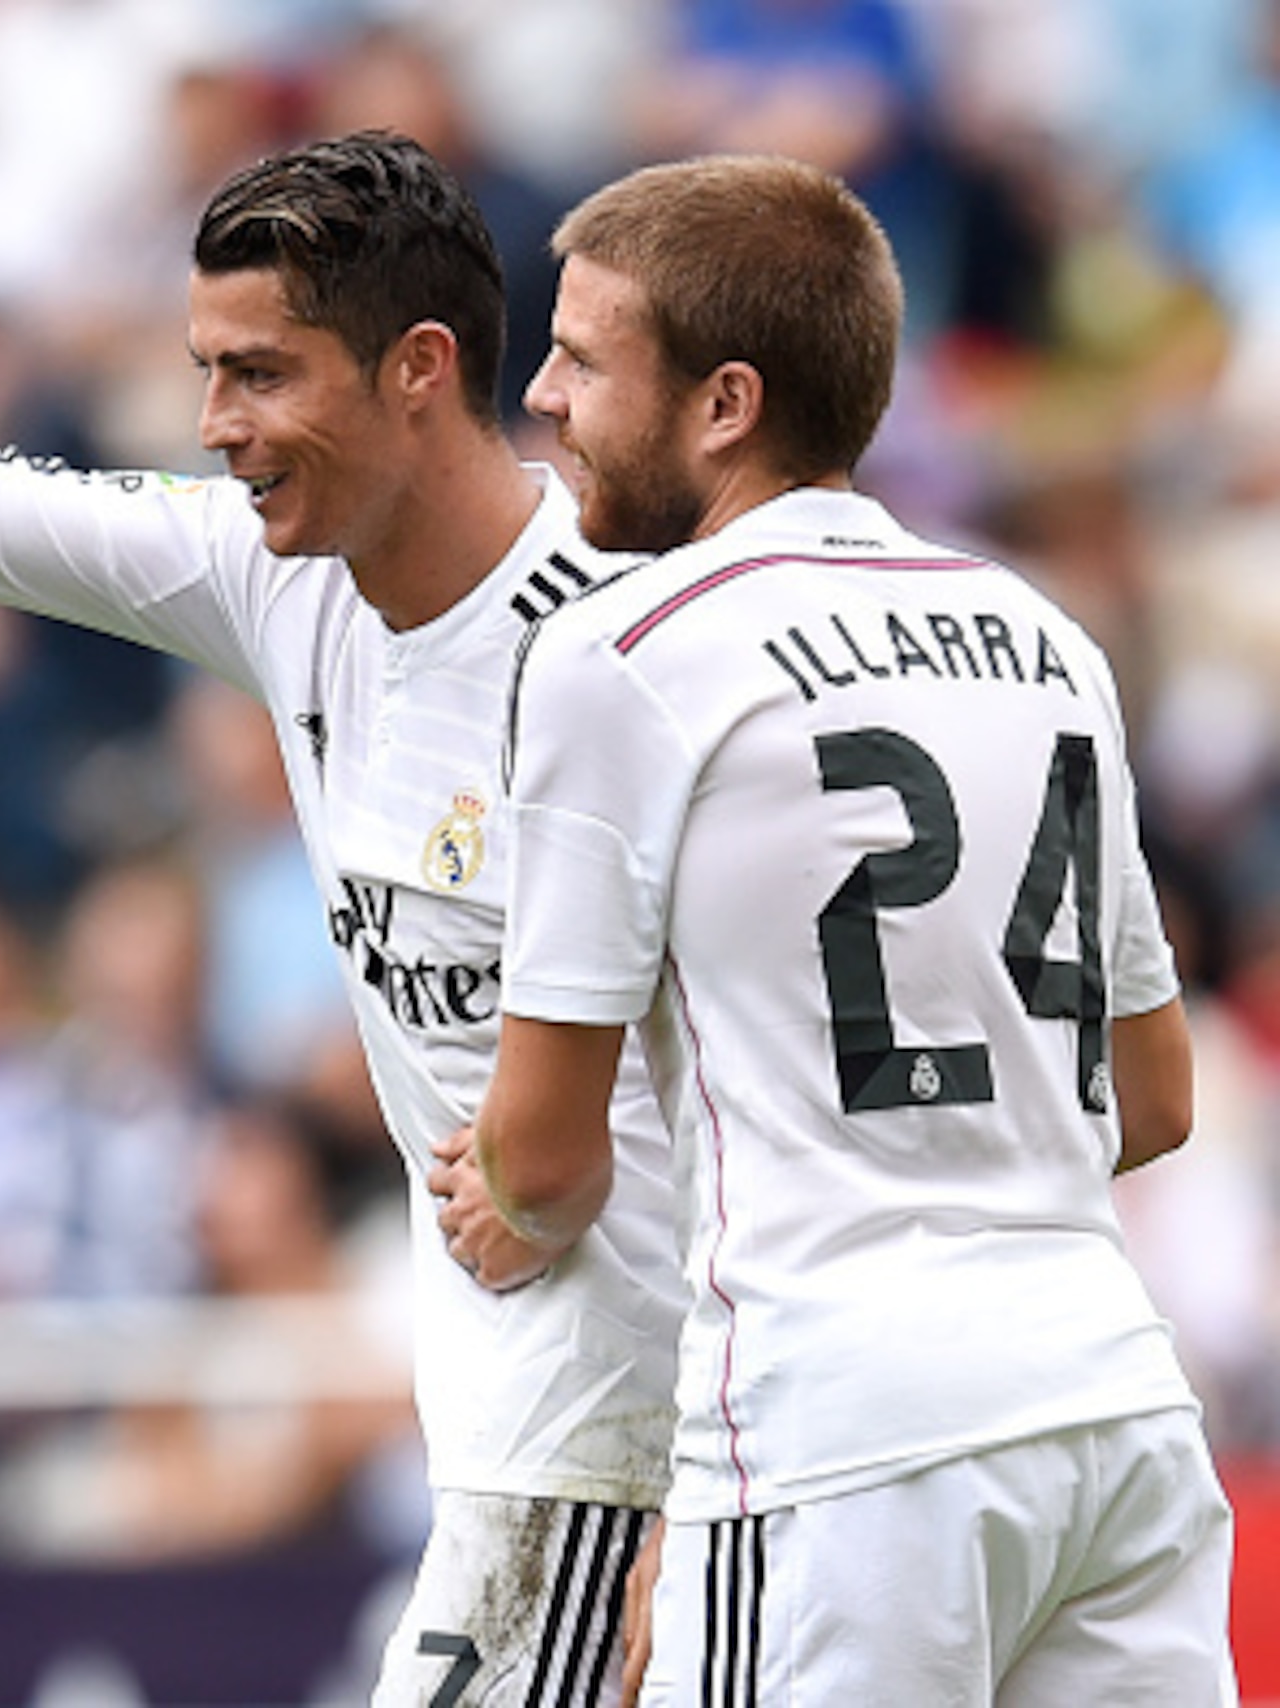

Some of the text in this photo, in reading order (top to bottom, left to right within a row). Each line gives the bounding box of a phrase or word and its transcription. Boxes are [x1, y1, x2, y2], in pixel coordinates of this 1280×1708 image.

[762, 611, 1078, 703] ILLARRA
[813, 727, 1107, 1115] 24
[420, 1634, 483, 1708] 7
